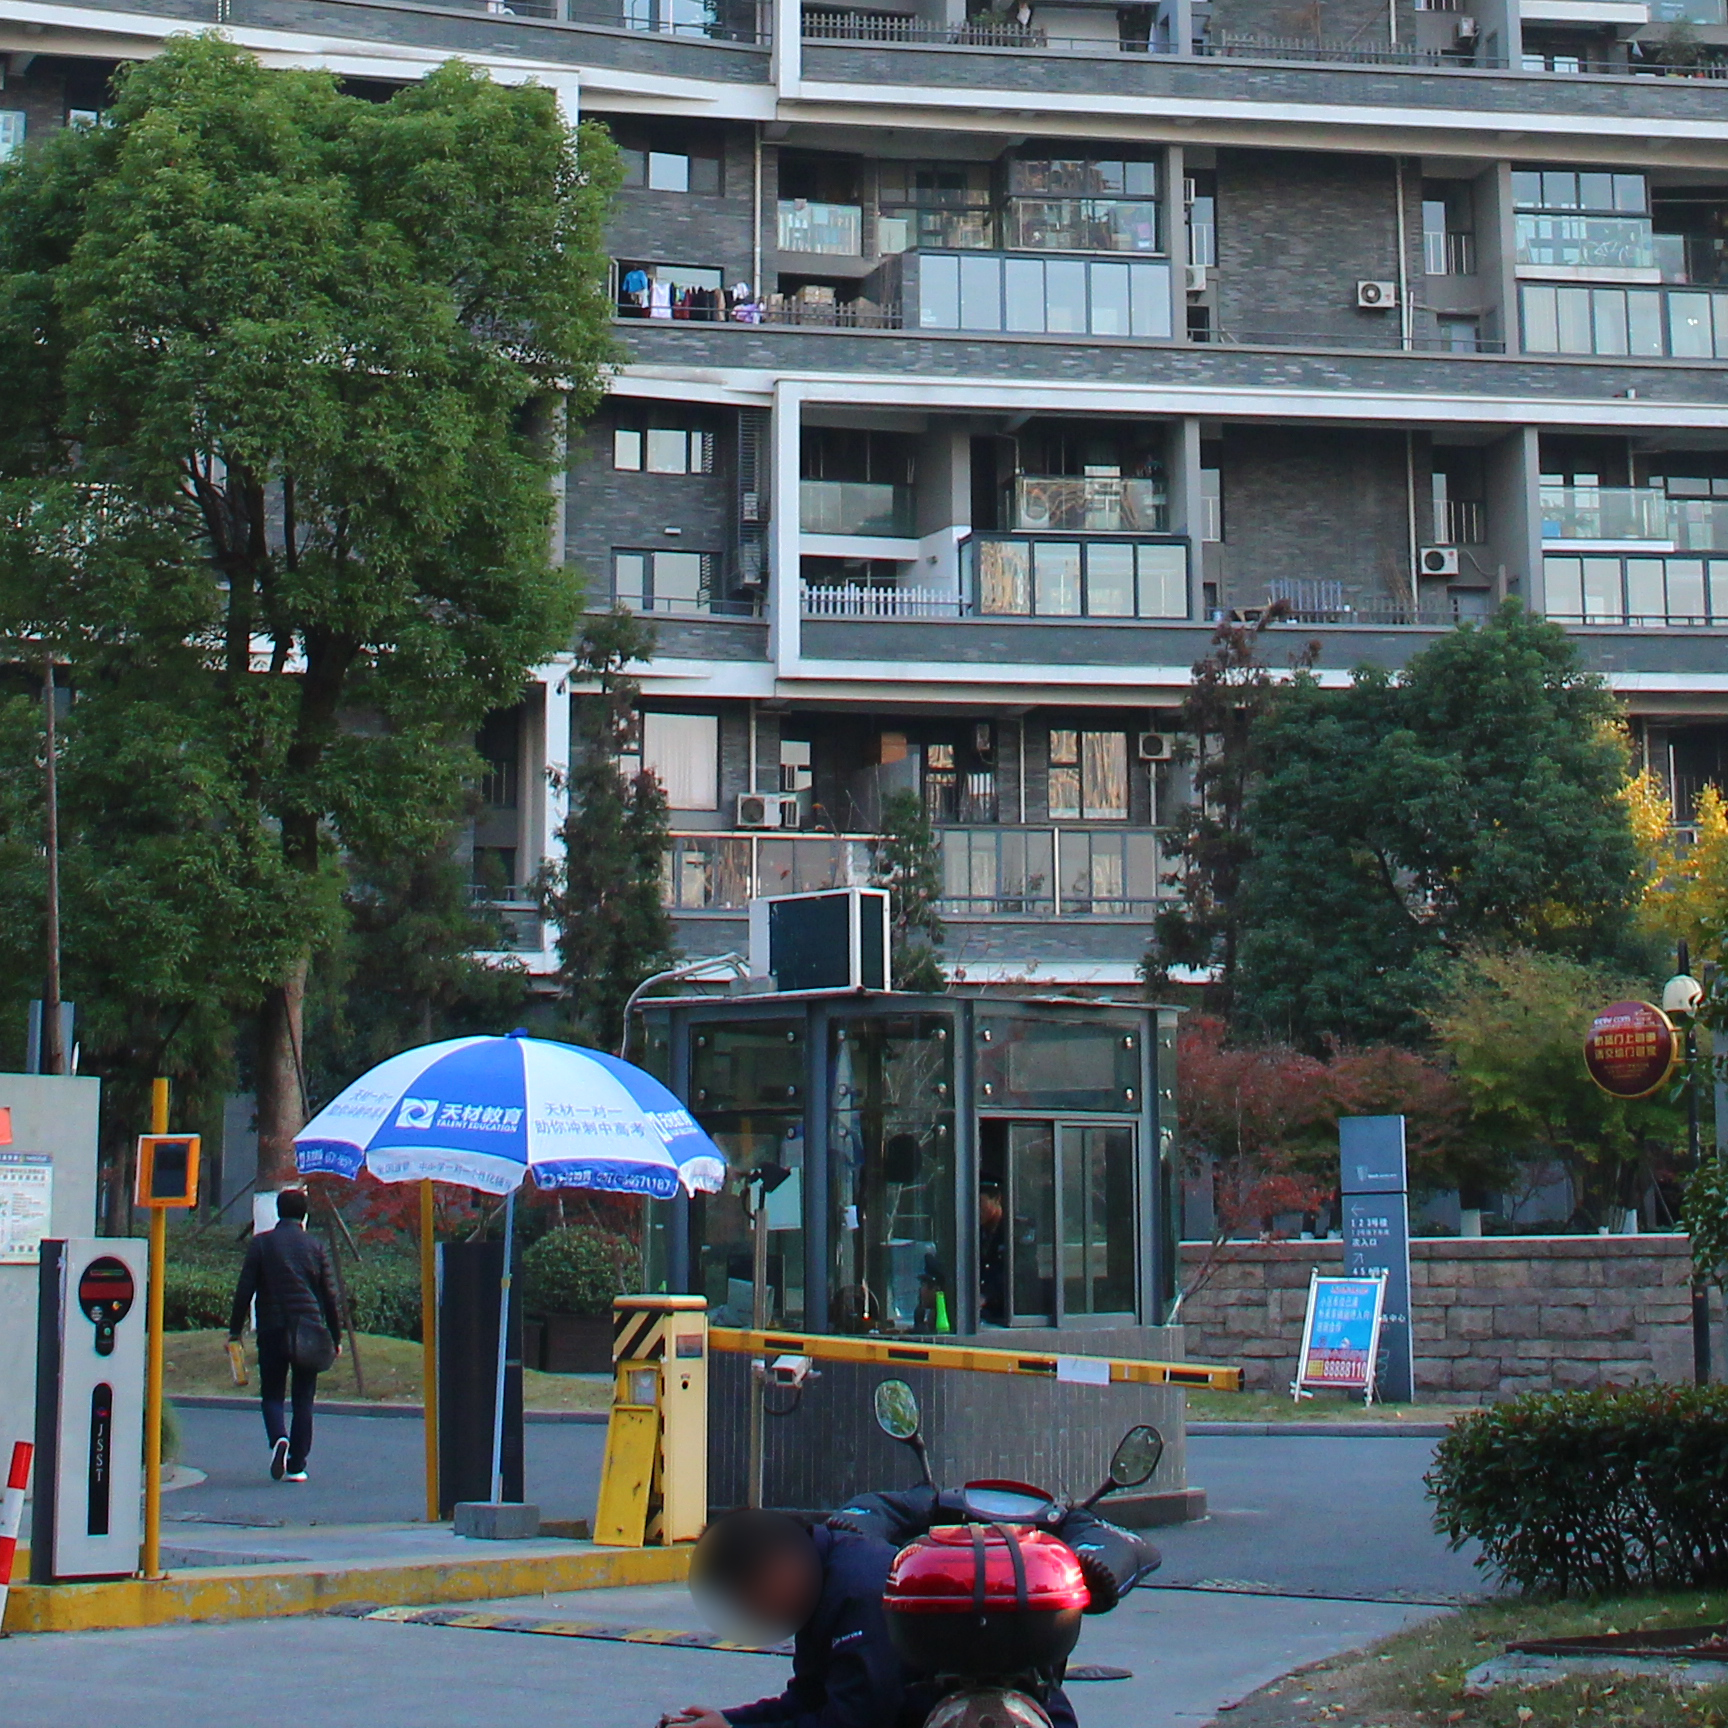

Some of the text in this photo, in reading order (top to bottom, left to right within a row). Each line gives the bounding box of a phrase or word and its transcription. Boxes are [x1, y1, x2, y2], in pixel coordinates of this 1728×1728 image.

[441, 1103, 523, 1125] 天材教育
[544, 1102, 623, 1119] 天材一对一
[436, 1119, 518, 1133] TALENT EDUCATION
[534, 1120, 647, 1138] 助你冲刺中高考
